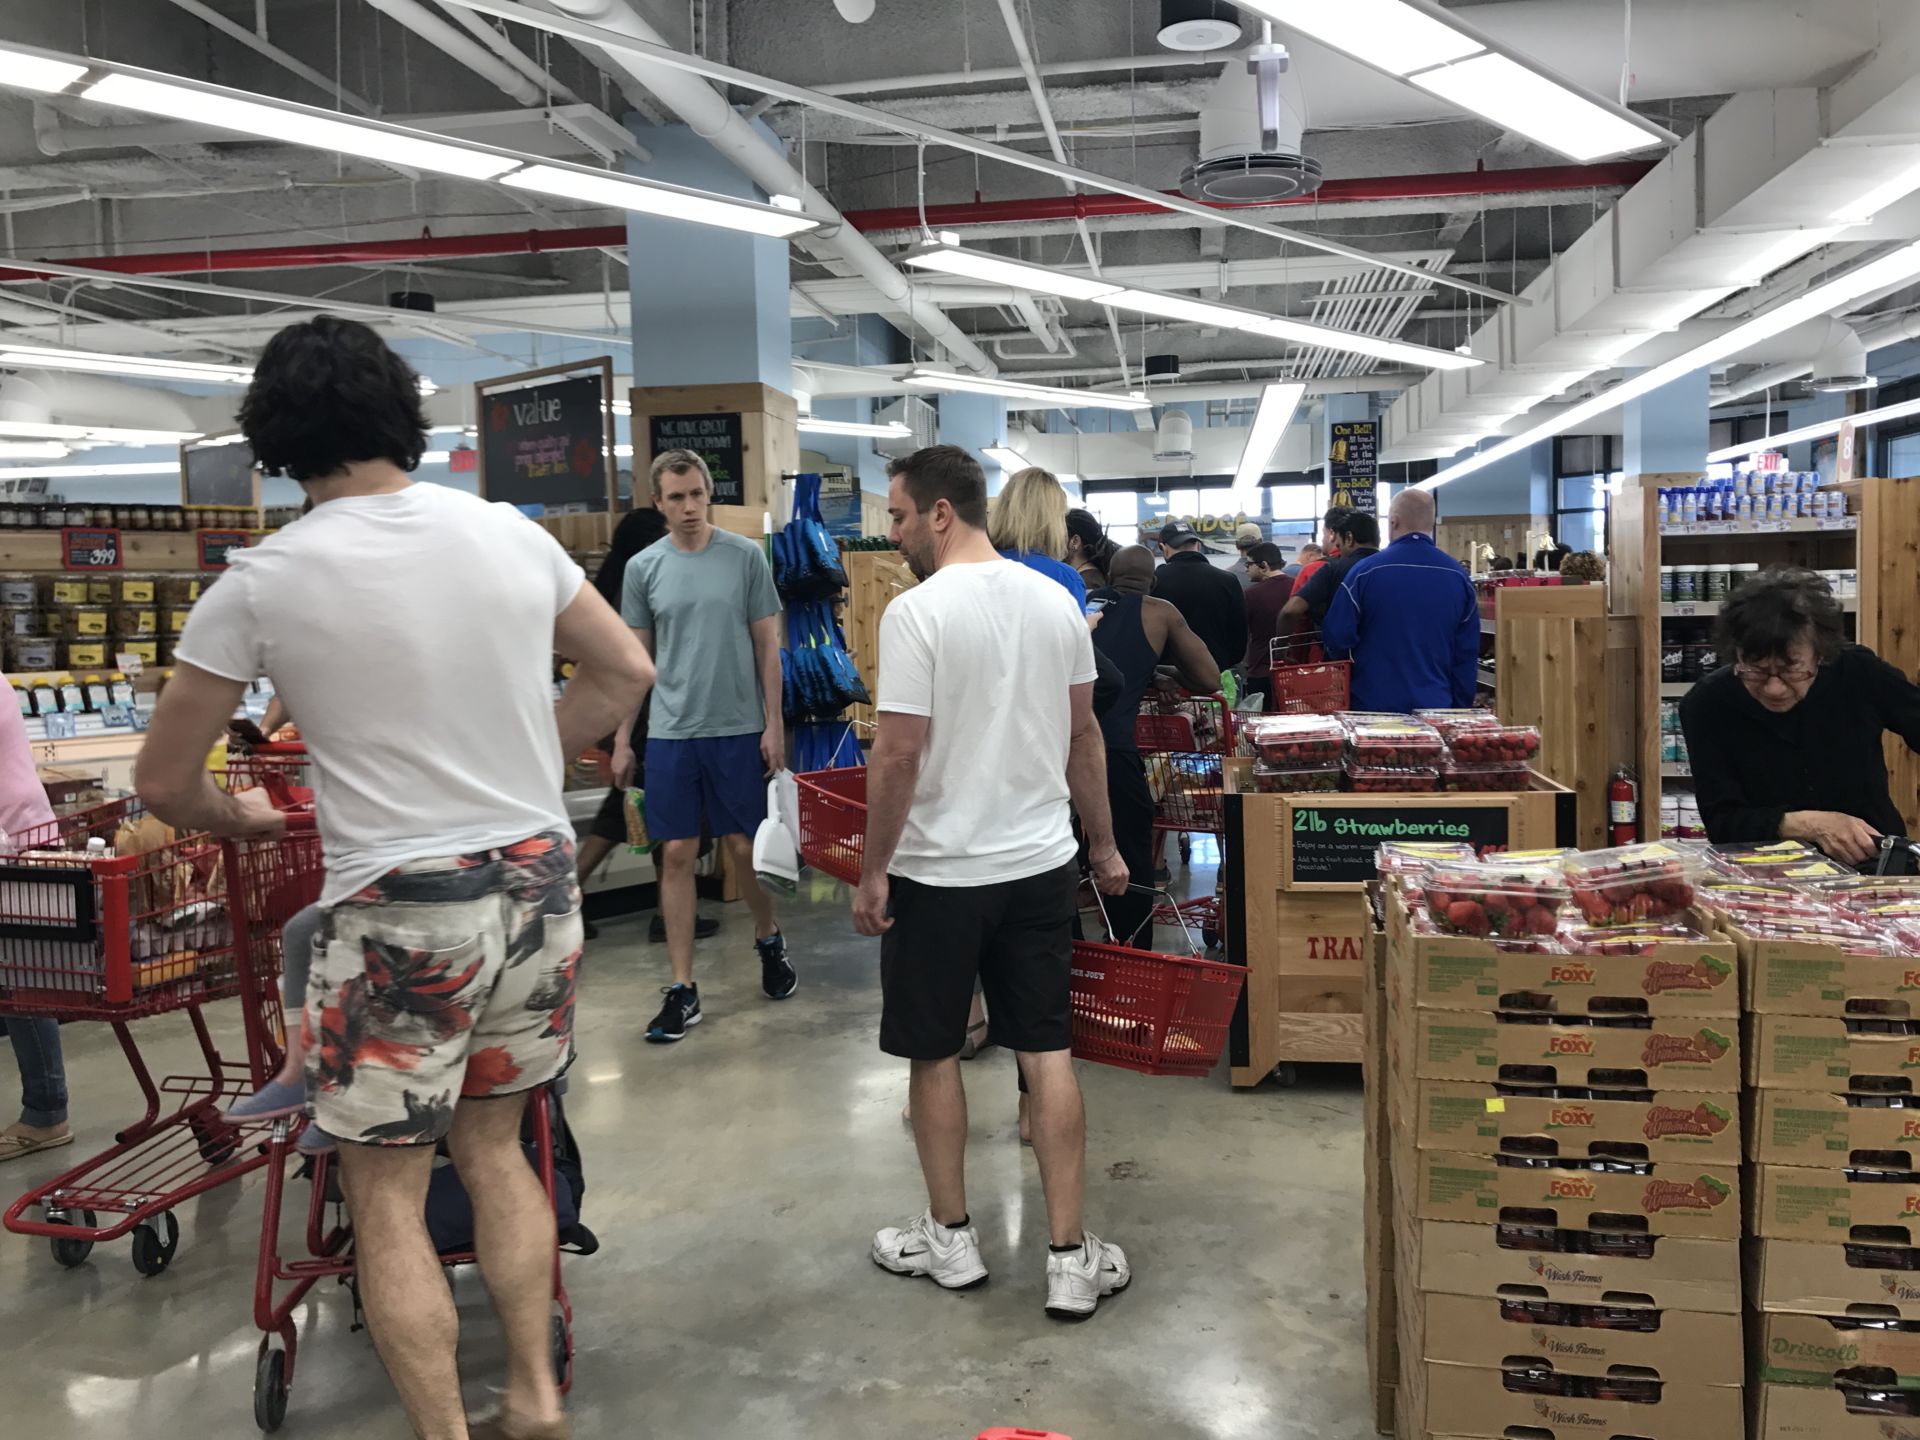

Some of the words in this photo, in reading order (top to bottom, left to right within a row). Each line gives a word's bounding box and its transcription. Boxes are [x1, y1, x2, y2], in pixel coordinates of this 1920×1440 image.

[513, 390, 562, 426] value
[1353, 423, 1372, 434] Bell!
[1843, 436, 1852, 459] 8
[1757, 454, 1778, 471] EXIT
[1294, 810, 1327, 832] 2lb
[1334, 818, 1470, 838] Strawberries
[1307, 936, 1364, 960] TRA
[1551, 966, 1594, 983] FOXY
[1550, 1037, 1593, 1053] FOXY
[1551, 1109, 1594, 1125] FOXY
[1551, 1181, 1594, 1197] FOXY
[1545, 1268, 1571, 1281] Wish
[1572, 1271, 1602, 1283] Farms
[1549, 1340, 1575, 1353] Wish
[1575, 1343, 1606, 1356] Farms
[1550, 1410, 1576, 1424] Wish
[1576, 1413, 1607, 1426] Farms
